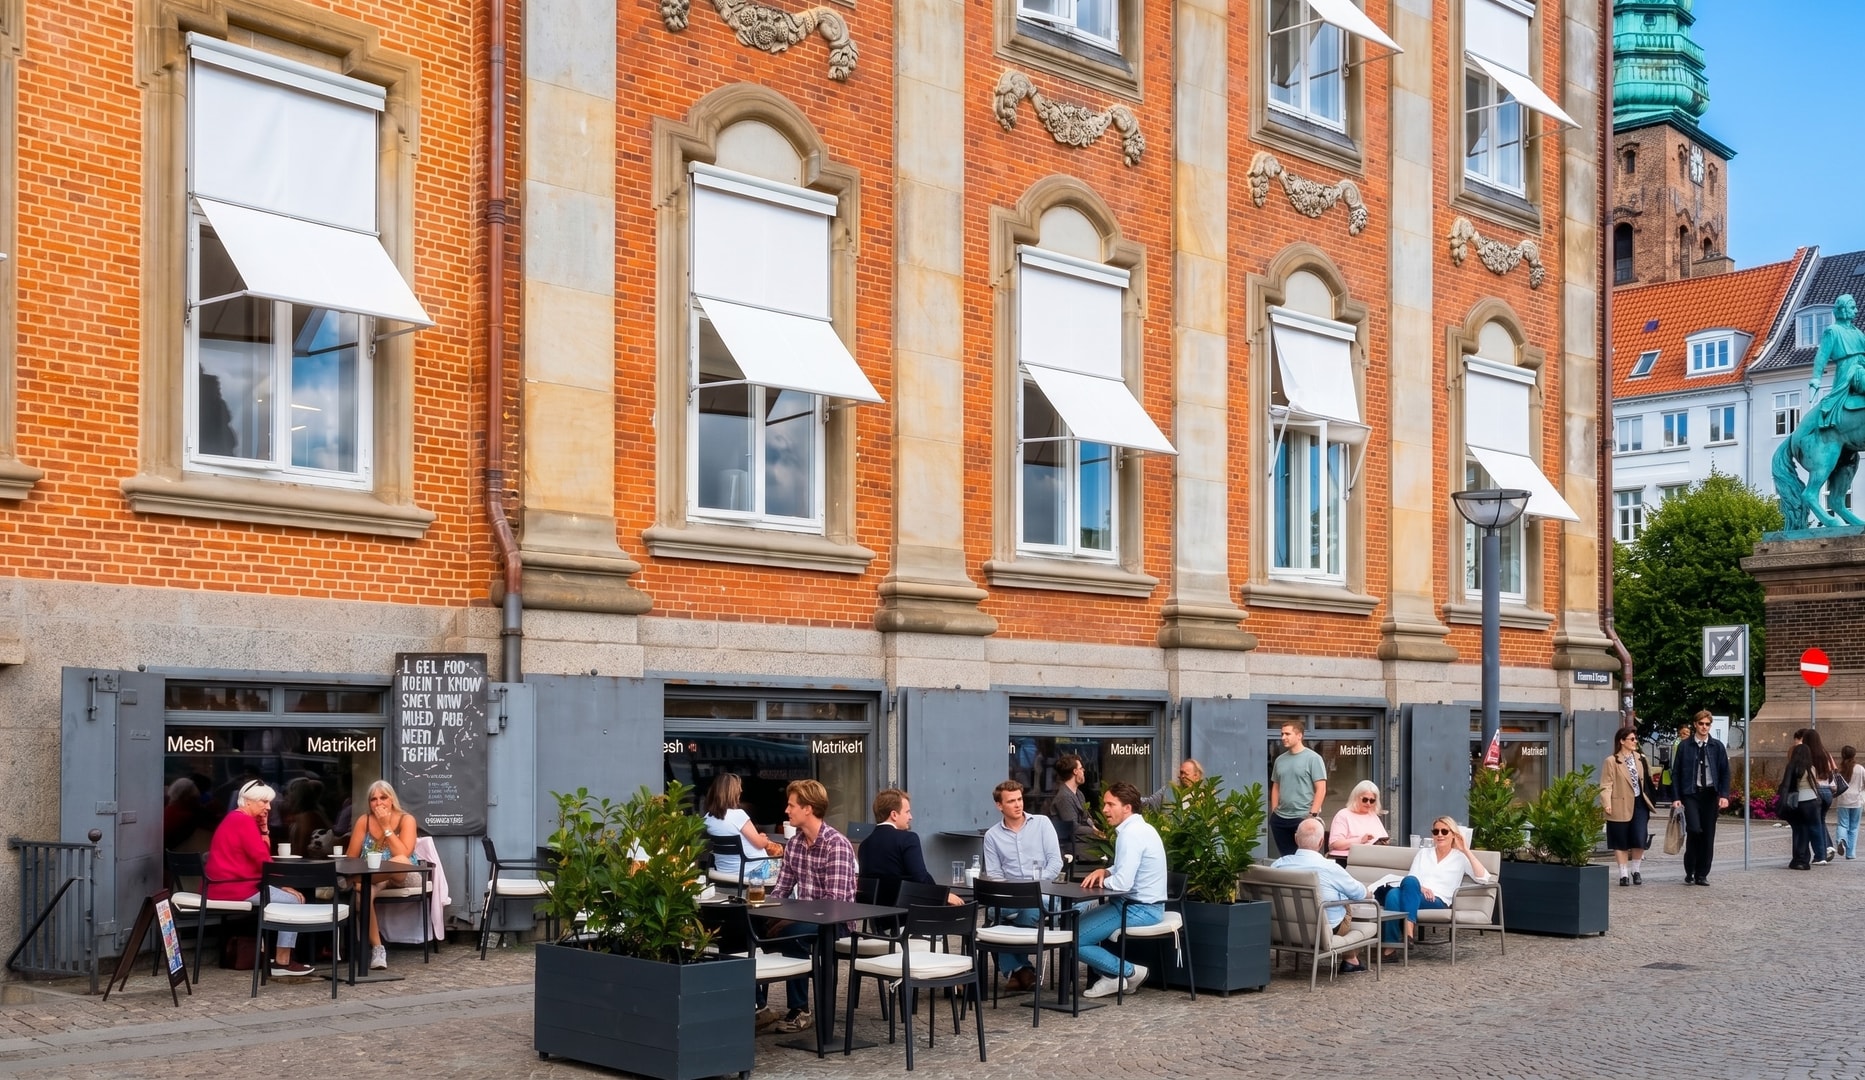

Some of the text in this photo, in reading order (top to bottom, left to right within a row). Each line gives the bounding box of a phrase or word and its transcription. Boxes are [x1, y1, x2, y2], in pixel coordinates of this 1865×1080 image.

[447, 676, 482, 693] KNOW
[167, 735, 215, 753] Mesh
[307, 736, 377, 753] Matrikel1
[436, 728, 446, 746] A
[663, 739, 684, 753] esh
[812, 740, 863, 754] Matrikel1
